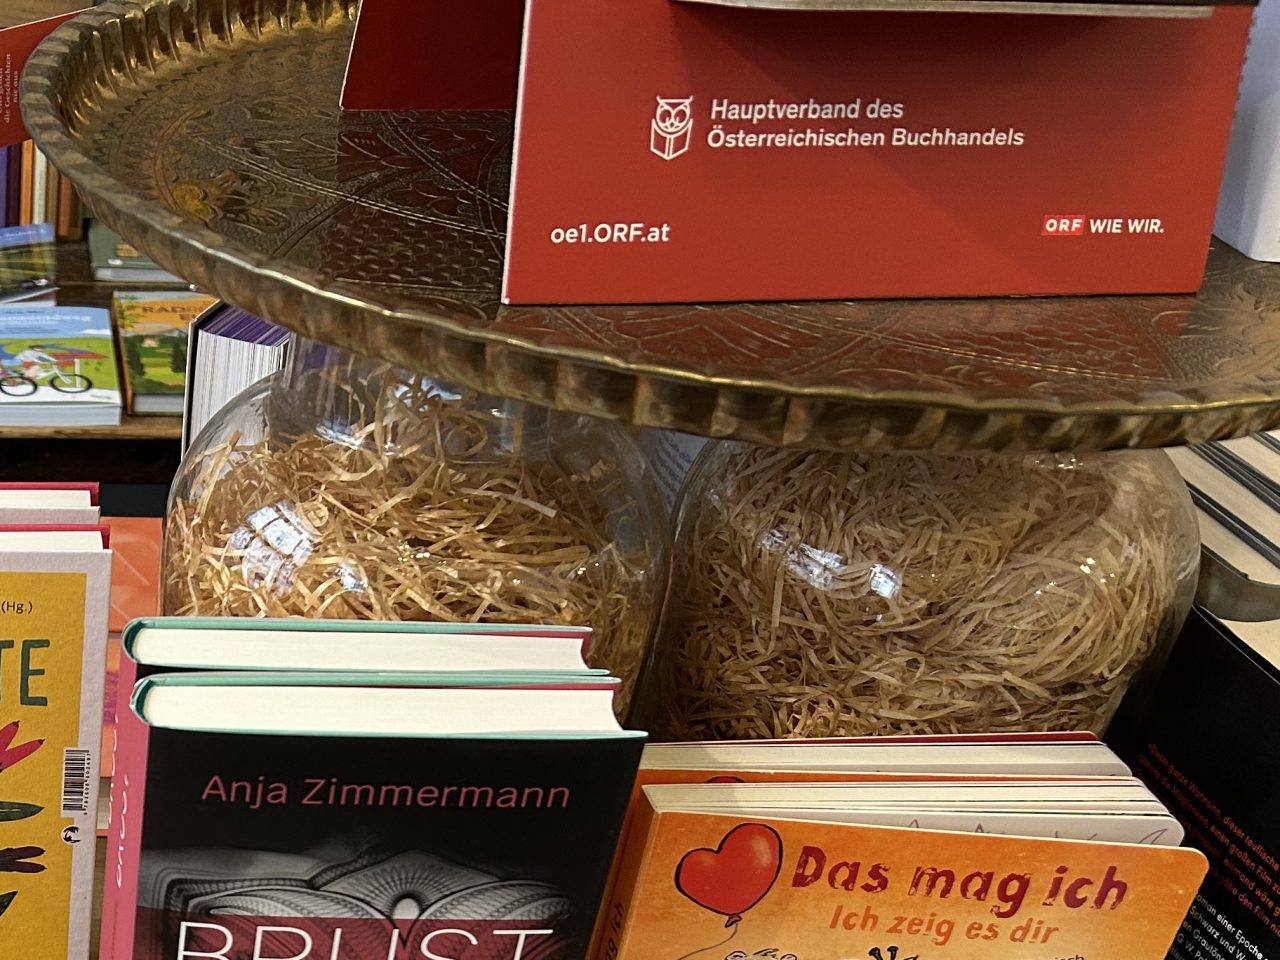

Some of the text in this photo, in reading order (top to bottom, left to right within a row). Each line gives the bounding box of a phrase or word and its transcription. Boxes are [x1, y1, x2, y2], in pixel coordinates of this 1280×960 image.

[710, 97, 904, 123] Hauptverband des
[707, 125, 1024, 148] Österreichischen Buchhandels
[550, 222, 670, 245] oe1.ORF.at
[1045, 218, 1165, 234] ORF WIE WIR.
[1, 600, 34, 614] (Hg.)
[201, 775, 570, 809] Anja Zimmermann
[792, 845, 1130, 919] Das mag ich
[829, 904, 1059, 946] Ich zeig es dir
[1189, 905, 1220, 939] Schwarz
[1235, 930, 1263, 960] Epoche
